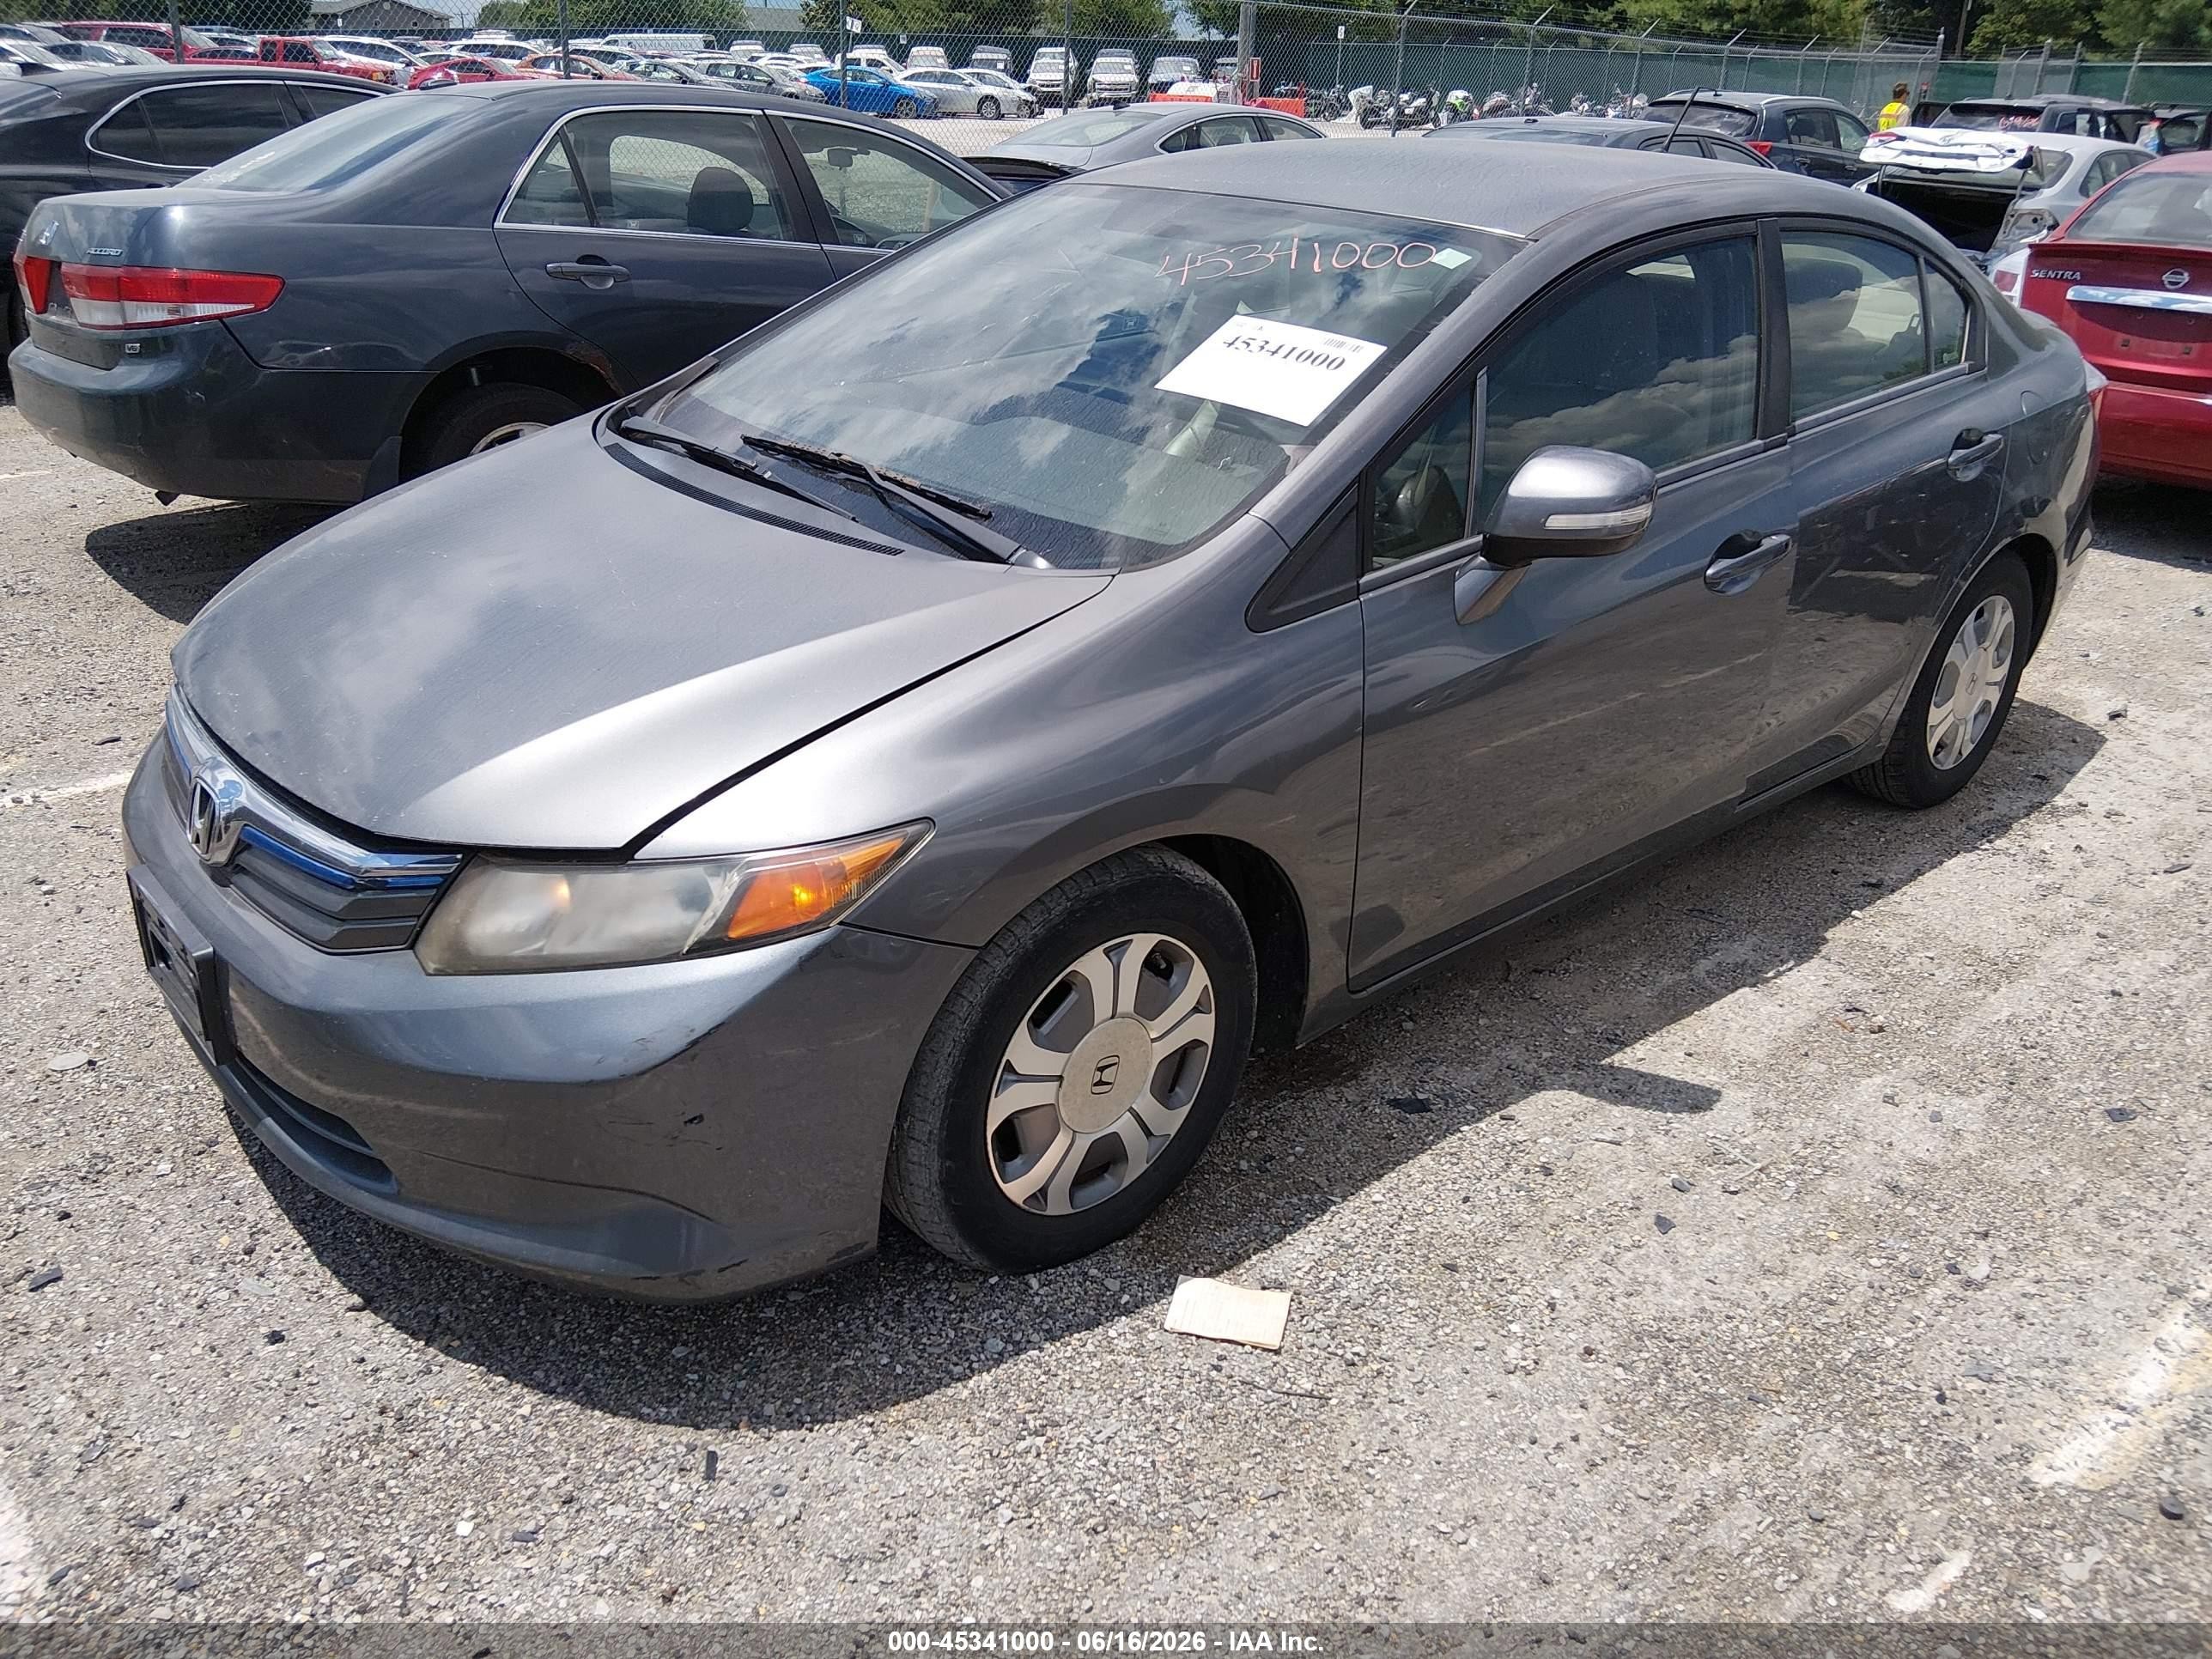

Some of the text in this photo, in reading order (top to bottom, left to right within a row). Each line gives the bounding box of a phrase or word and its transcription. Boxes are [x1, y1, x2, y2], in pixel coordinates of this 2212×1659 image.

[1154, 236, 1437, 286] 45341000
[2030, 269, 2081, 281] SENTRA
[1223, 335, 1346, 371] 45341000
